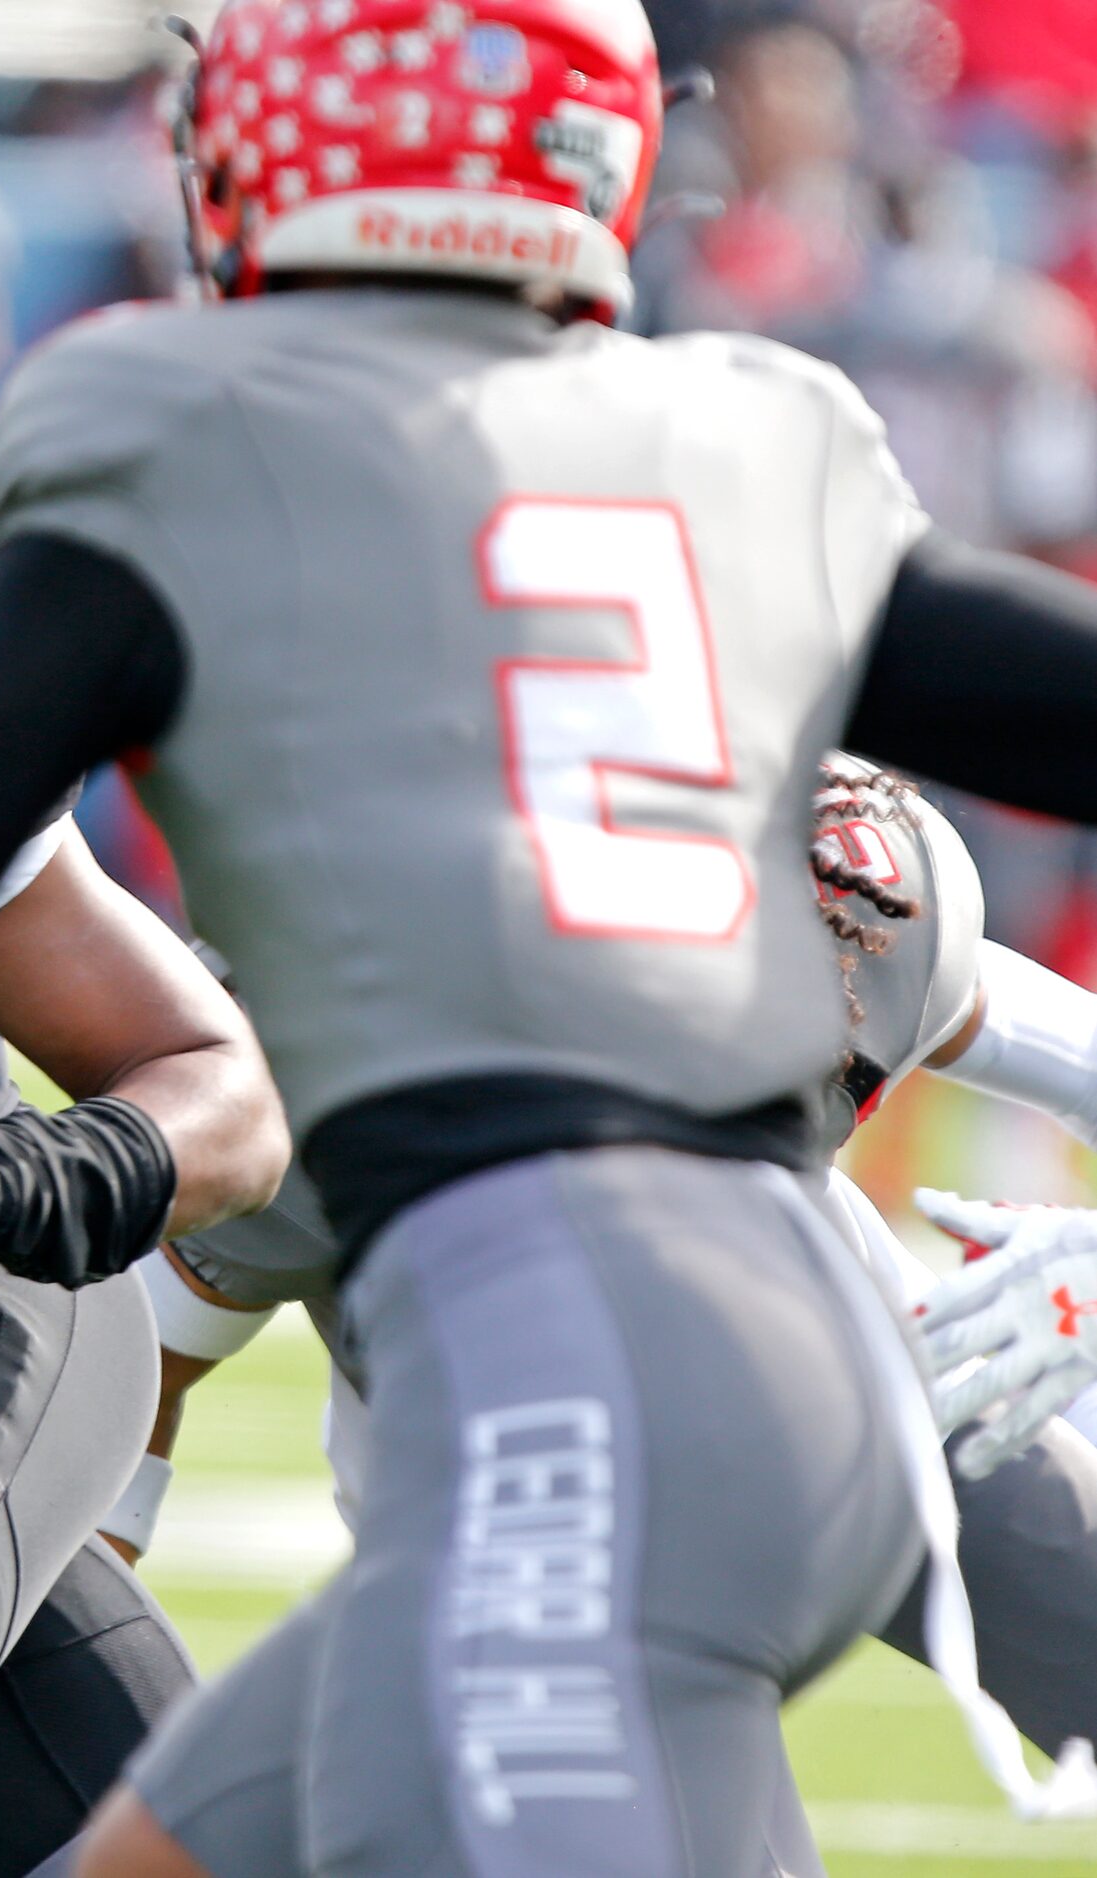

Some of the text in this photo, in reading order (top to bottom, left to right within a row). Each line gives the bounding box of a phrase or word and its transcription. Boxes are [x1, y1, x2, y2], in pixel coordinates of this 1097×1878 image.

[356, 212, 580, 272] Riddell
[474, 494, 758, 946] 2
[450, 1397, 640, 1828] CEDAR HILL
